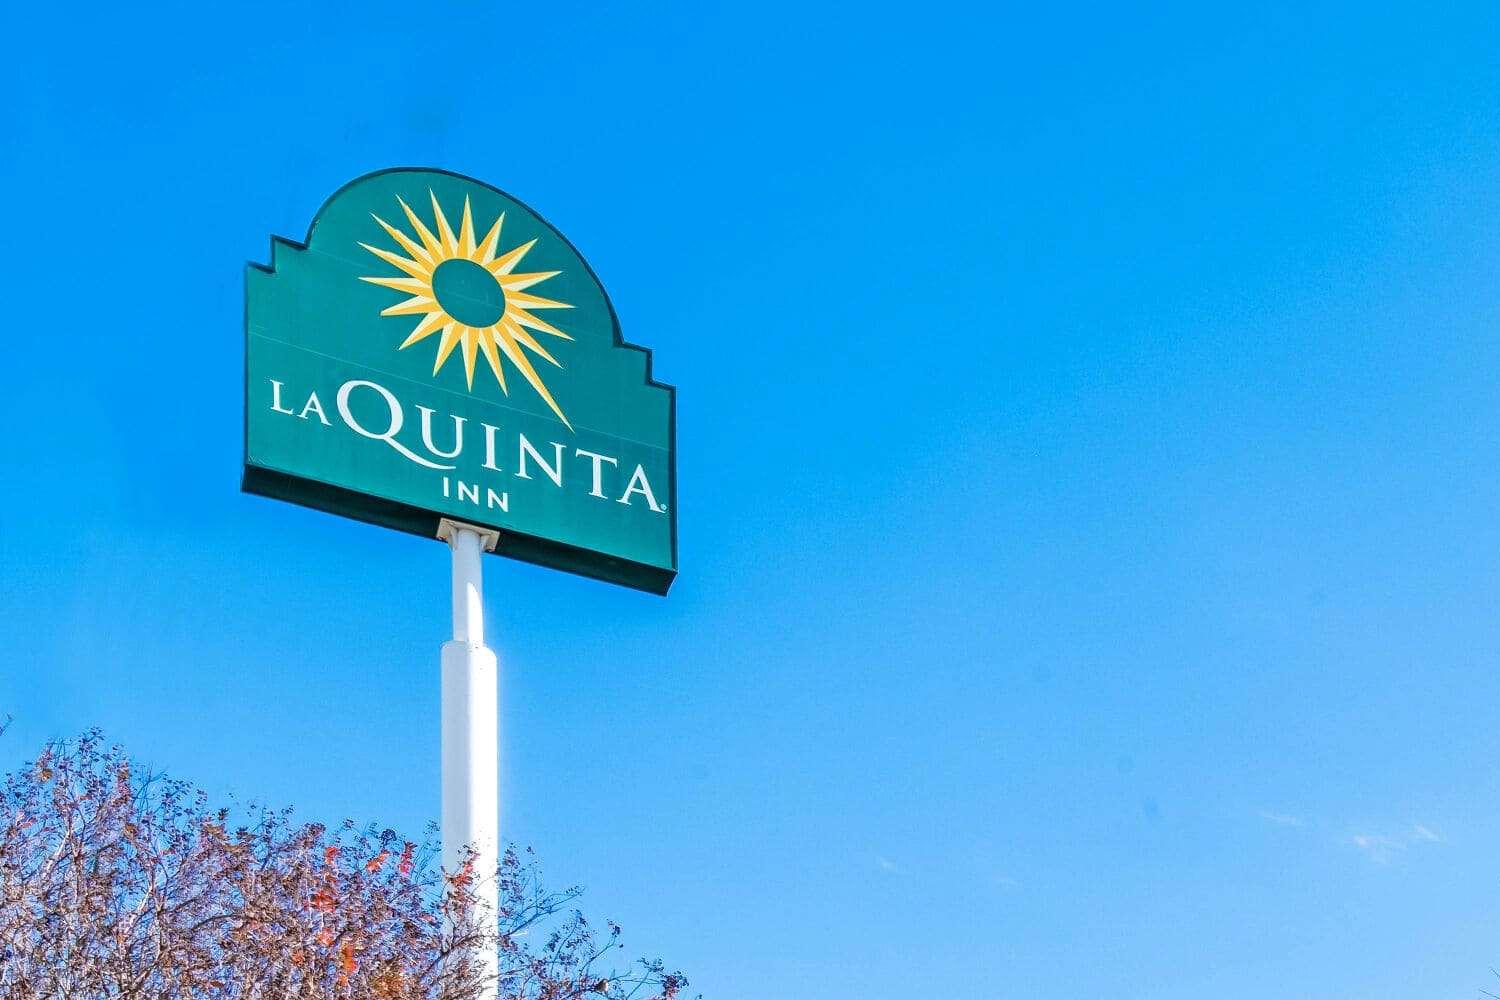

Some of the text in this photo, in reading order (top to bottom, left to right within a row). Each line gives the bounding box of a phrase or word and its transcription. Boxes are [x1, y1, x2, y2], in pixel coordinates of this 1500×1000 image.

[270, 379, 668, 514] LA QUINTA
[442, 476, 509, 513] INN
